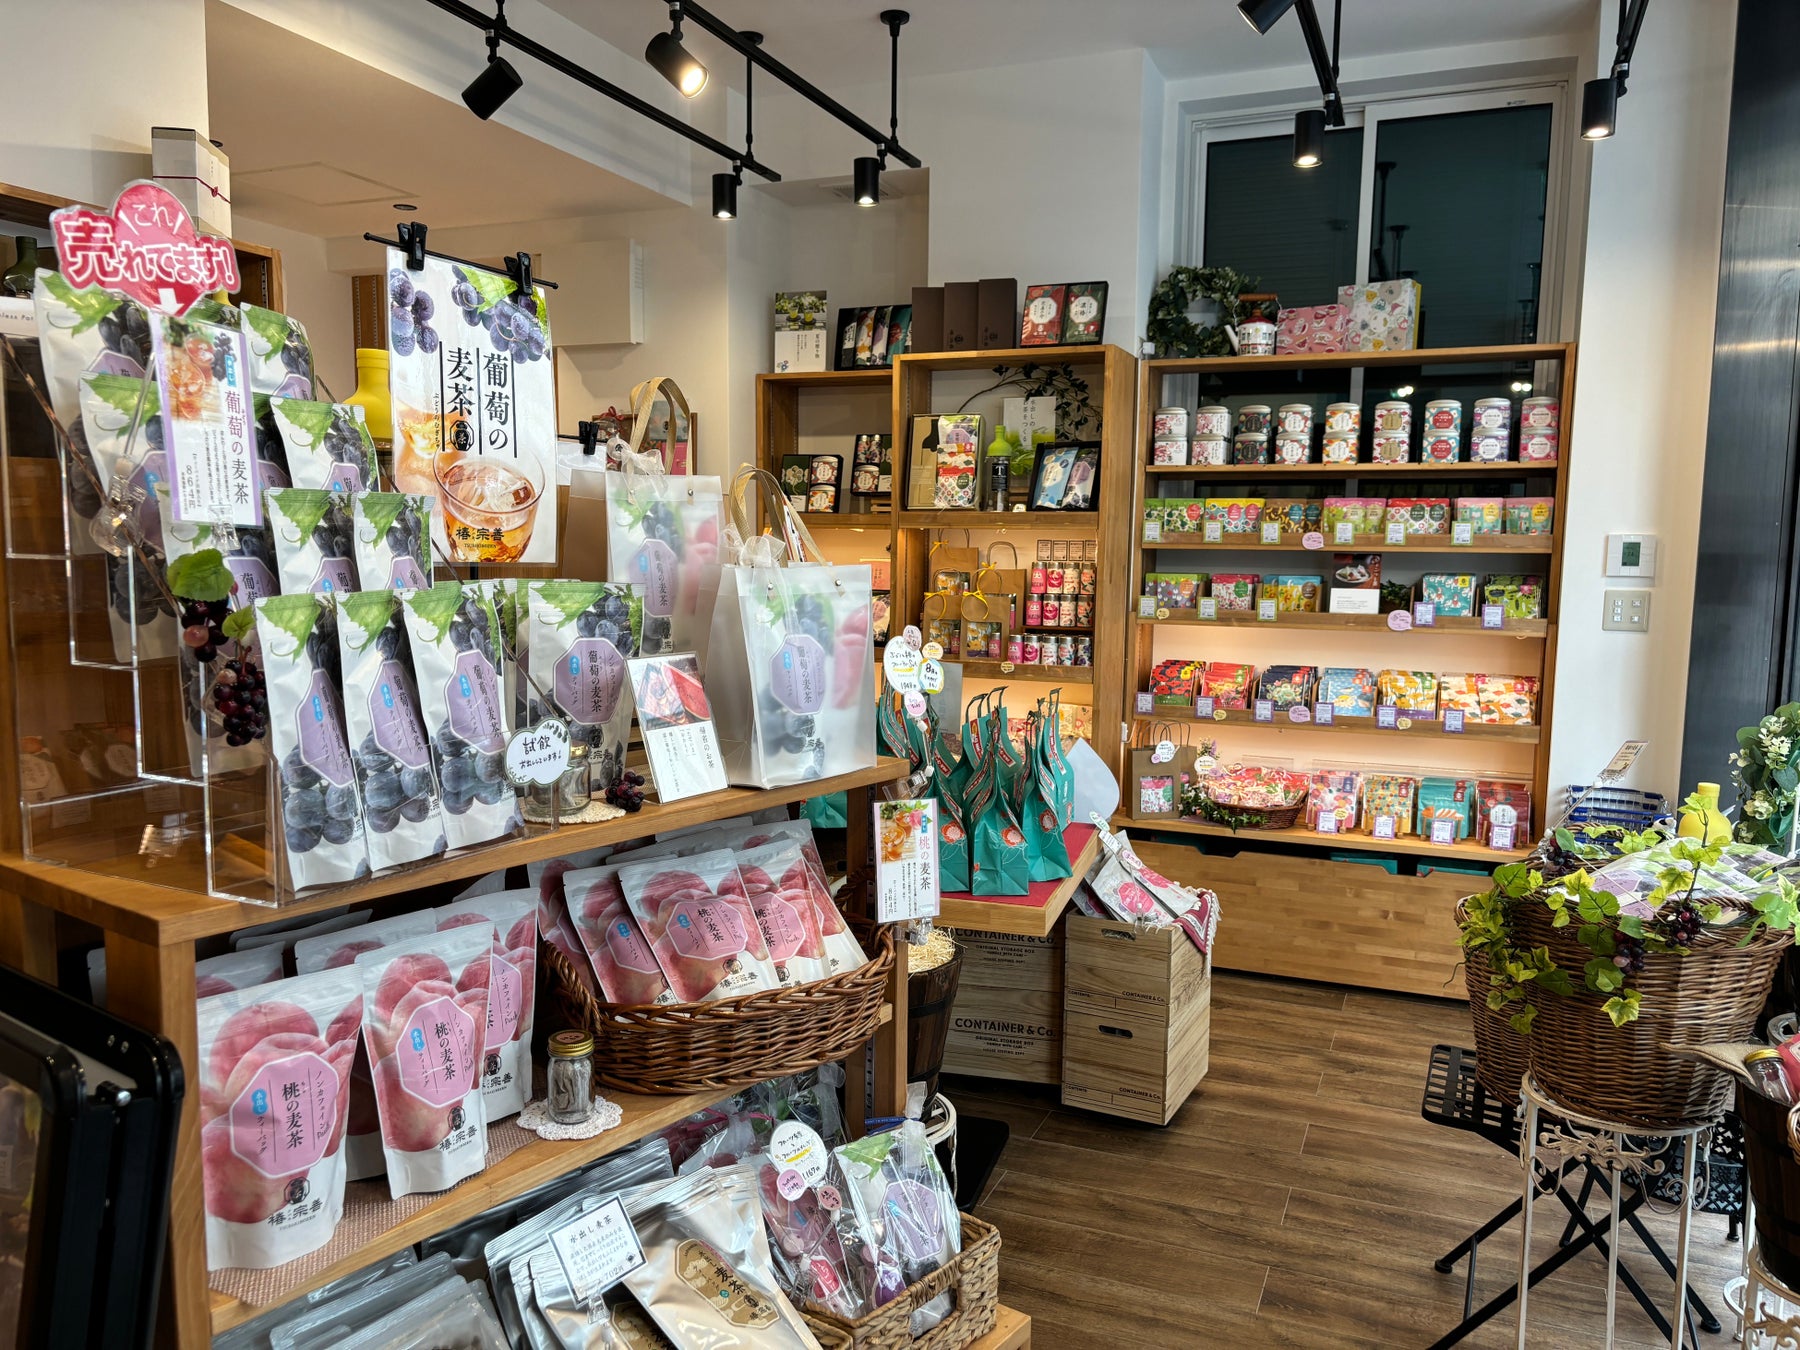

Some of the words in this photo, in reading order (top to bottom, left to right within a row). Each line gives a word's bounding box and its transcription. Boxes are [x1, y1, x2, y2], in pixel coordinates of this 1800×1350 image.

[131, 202, 173, 228] これ
[60, 216, 236, 286] 売れてます!
[447, 347, 475, 417] 麦茶
[483, 352, 509, 451] 葡萄の
[225, 390, 249, 505] 葡萄の麦茶
[588, 650, 602, 713] 葡萄の麦茶
[522, 735, 551, 755] 試飲
[919, 836, 931, 891] 桃の麦茶
[697, 908, 725, 943] 桃の麦茶
[1121, 990, 1152, 1001] CONTAINER
[434, 1023, 456, 1081] 桃の麦茶
[955, 1018, 1025, 1034] CONTAINER
[1026, 1025, 1035, 1035] &
[1037, 1026, 1057, 1037] Co.
[281, 1082, 304, 1149] 桃の麦茶
[1118, 1087, 1149, 1097] CONTAINER
[570, 1214, 613, 1244] 水出し麦茶
